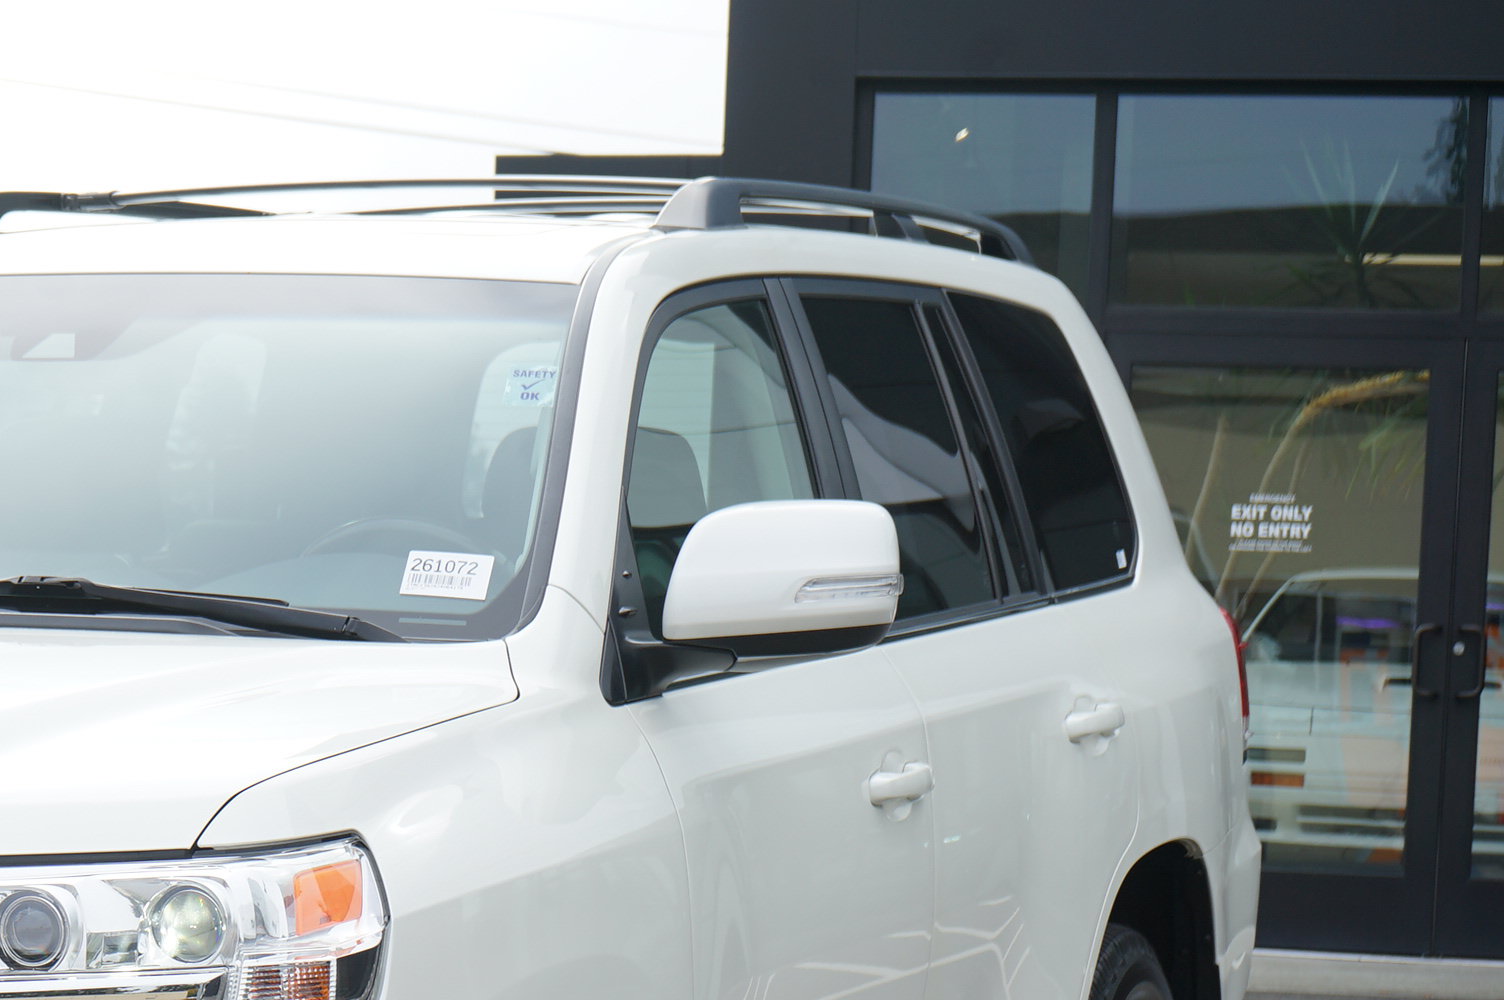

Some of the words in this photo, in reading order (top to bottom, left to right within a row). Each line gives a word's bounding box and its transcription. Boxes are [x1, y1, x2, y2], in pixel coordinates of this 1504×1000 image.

[512, 369, 556, 379] SAFETY
[520, 392, 540, 401] OK
[1231, 503, 1267, 521] EXIT
[1270, 505, 1313, 521] ONLY
[1230, 521, 1254, 538] NO
[1258, 522, 1312, 539] ENTRY
[411, 558, 478, 575] 261072
